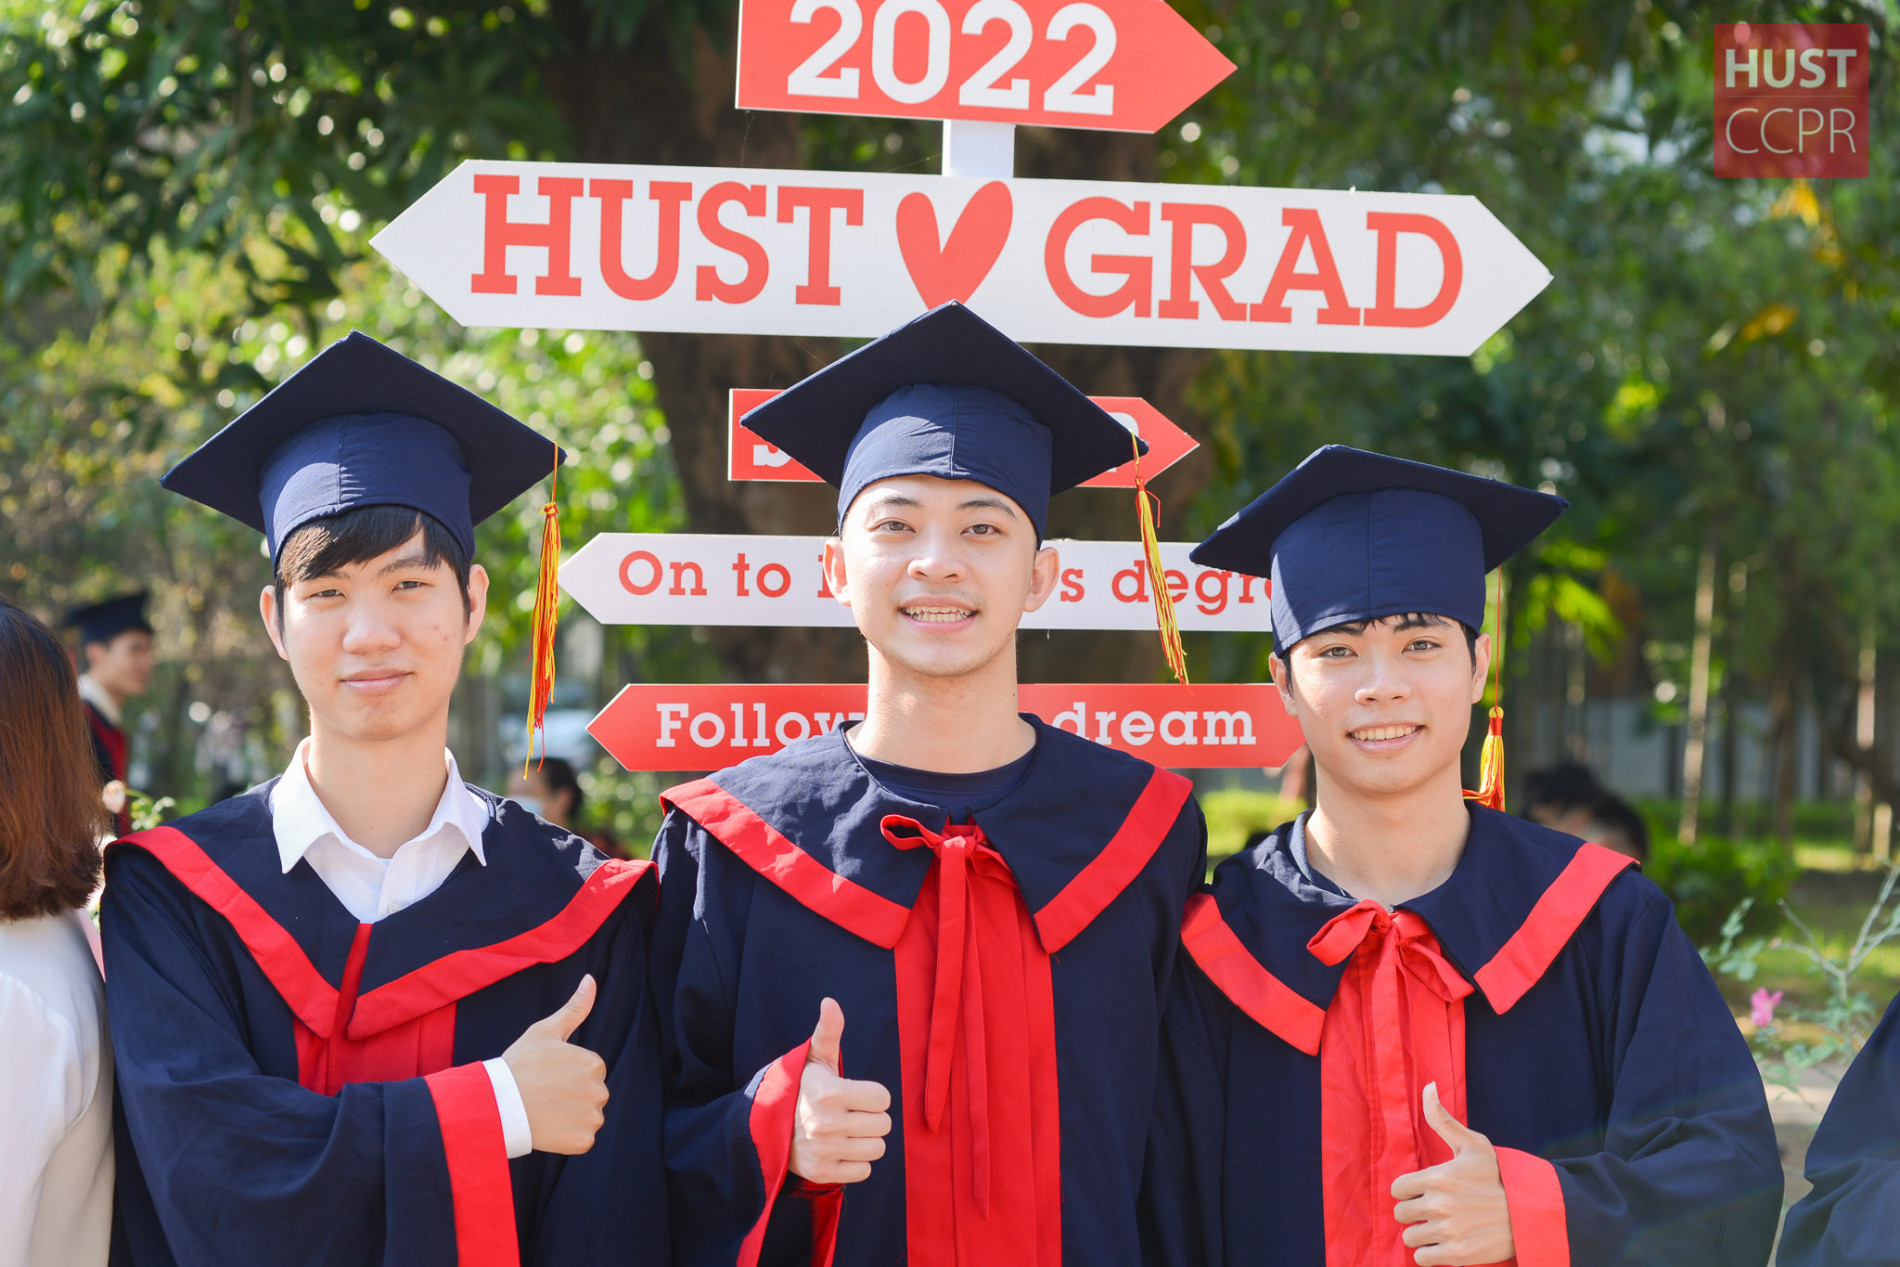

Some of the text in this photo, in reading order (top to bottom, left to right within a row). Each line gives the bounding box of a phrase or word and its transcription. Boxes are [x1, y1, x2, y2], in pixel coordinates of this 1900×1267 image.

[787, 0, 1117, 116] 2022
[470, 173, 1464, 328] HUST GRAD
[618, 550, 708, 596] On
[732, 552, 792, 598] to
[1111, 559, 1272, 616] degr
[1051, 701, 1257, 746] dream
